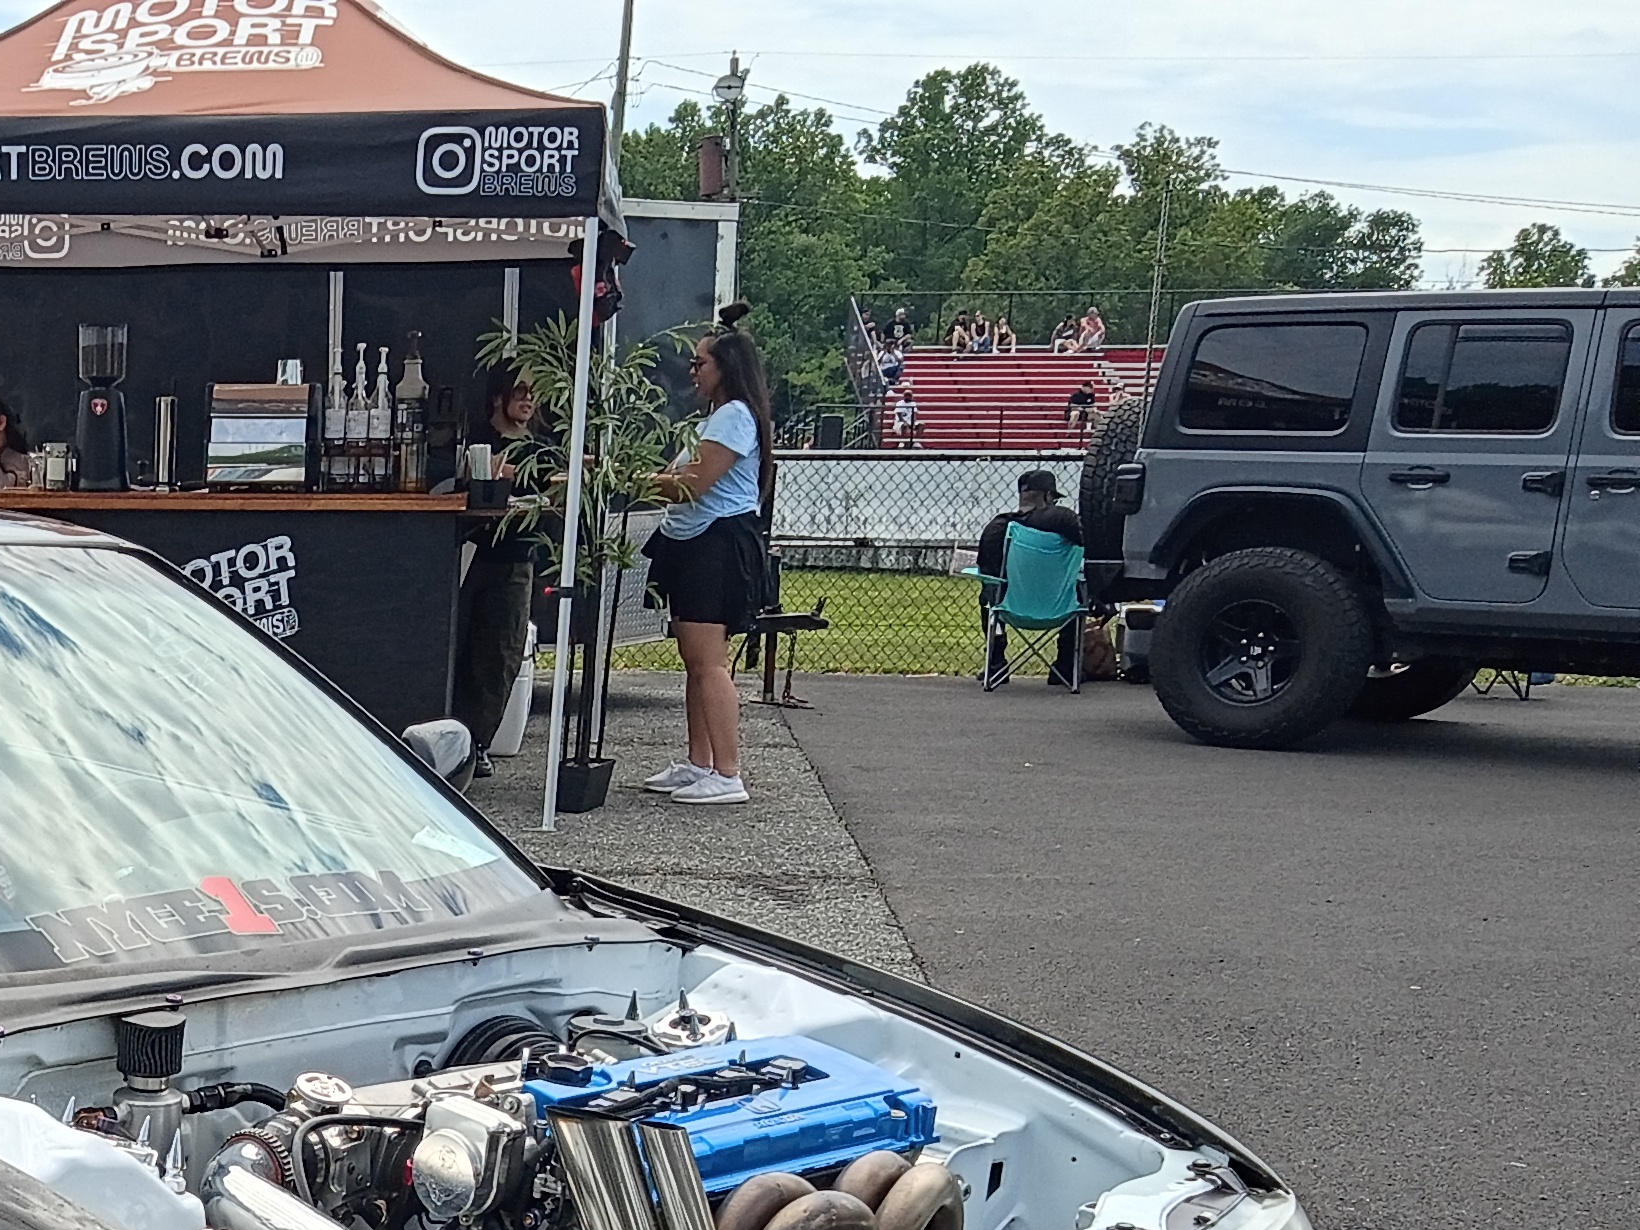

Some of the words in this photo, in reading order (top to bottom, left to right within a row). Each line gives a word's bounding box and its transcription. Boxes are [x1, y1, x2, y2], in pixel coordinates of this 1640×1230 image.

[72, 17, 334, 61] SPORT
[175, 49, 292, 69] BREWS
[484, 126, 579, 149] MOTOR
[482, 150, 579, 173] SPORT
[480, 173, 577, 196] BREWS
